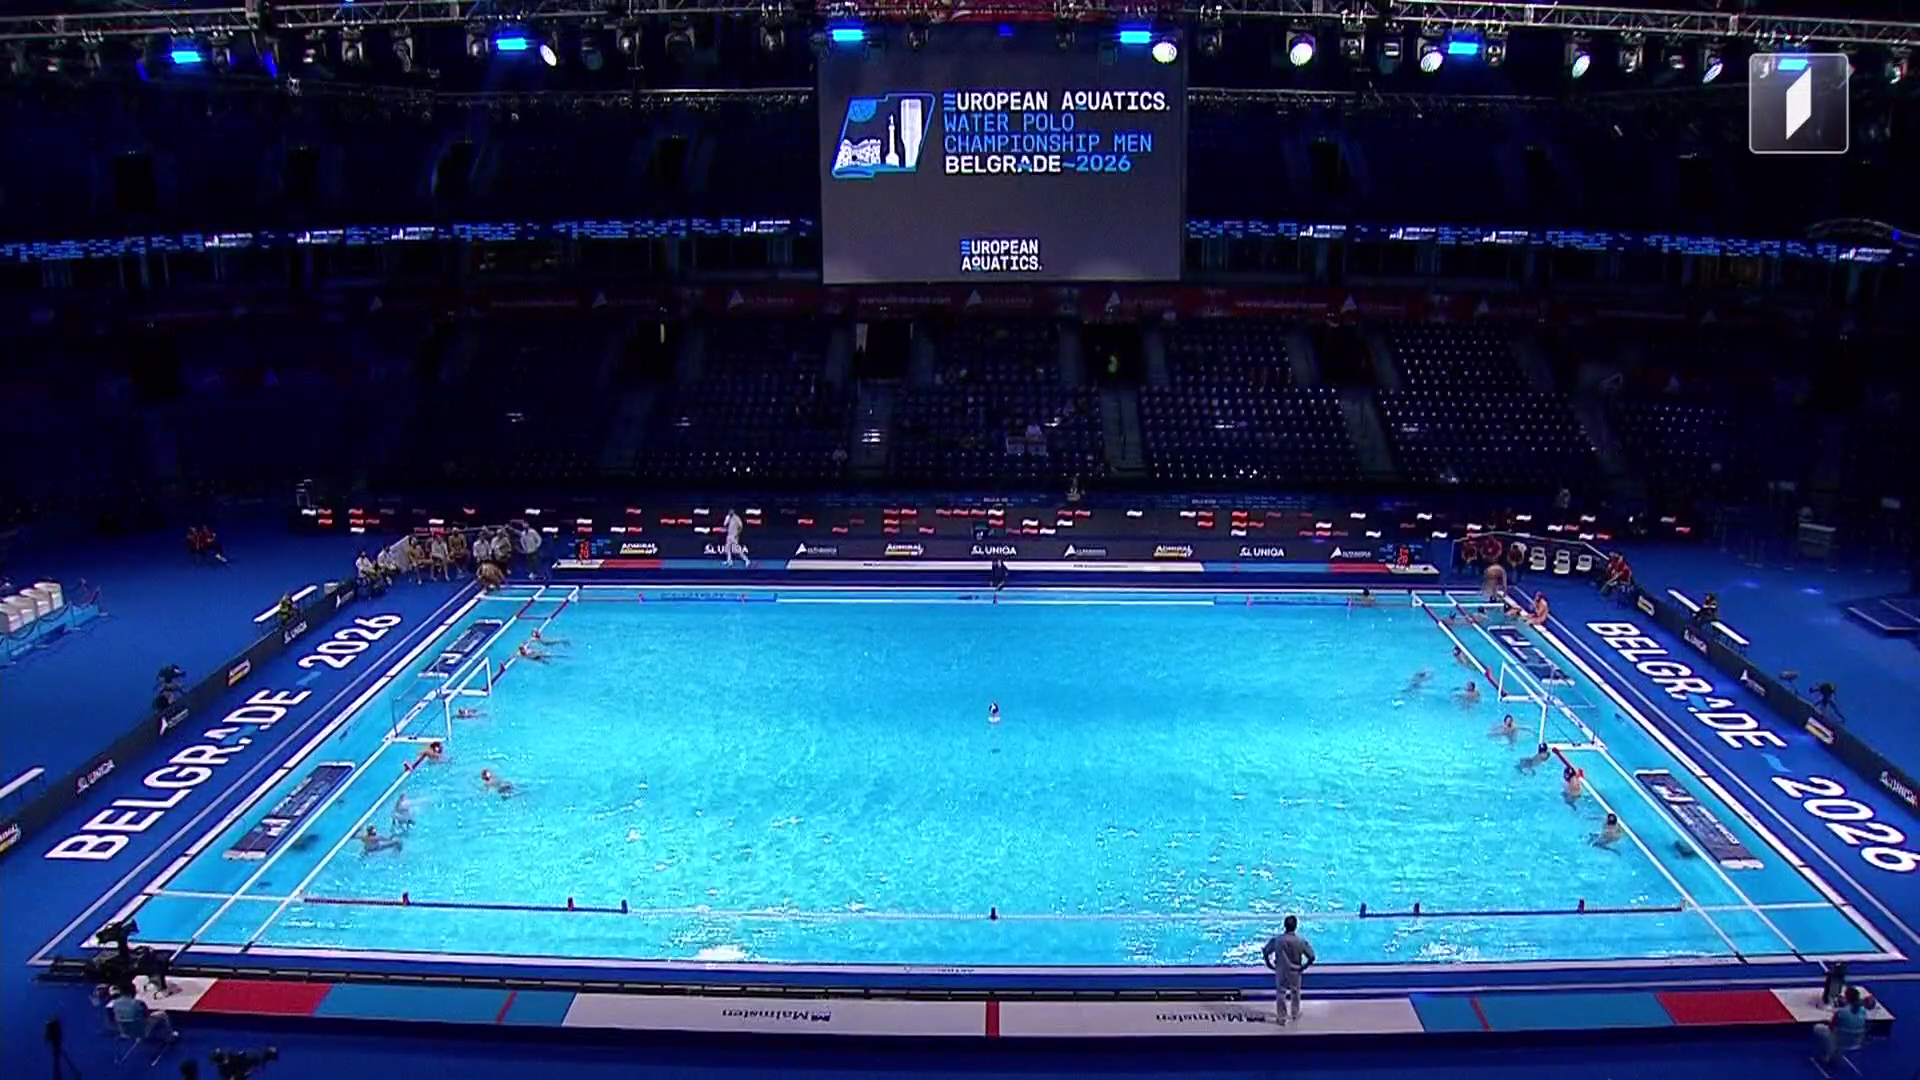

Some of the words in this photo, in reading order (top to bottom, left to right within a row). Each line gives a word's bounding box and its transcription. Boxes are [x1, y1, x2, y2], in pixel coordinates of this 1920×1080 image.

[943, 92, 1048, 111] EUROPEAN
[943, 113, 1008, 132] WATER
[1023, 113, 1075, 131] POLO
[944, 134, 1100, 153] CHAMPIONSHIP
[1114, 134, 1152, 152] MEN
[960, 240, 1039, 255] EUROPEAN
[44, 689, 312, 860] BELGRADE
[298, 613, 402, 669] 2026
[1586, 622, 1788, 749] BELGRADE
[1771, 776, 1920, 872] 2026
